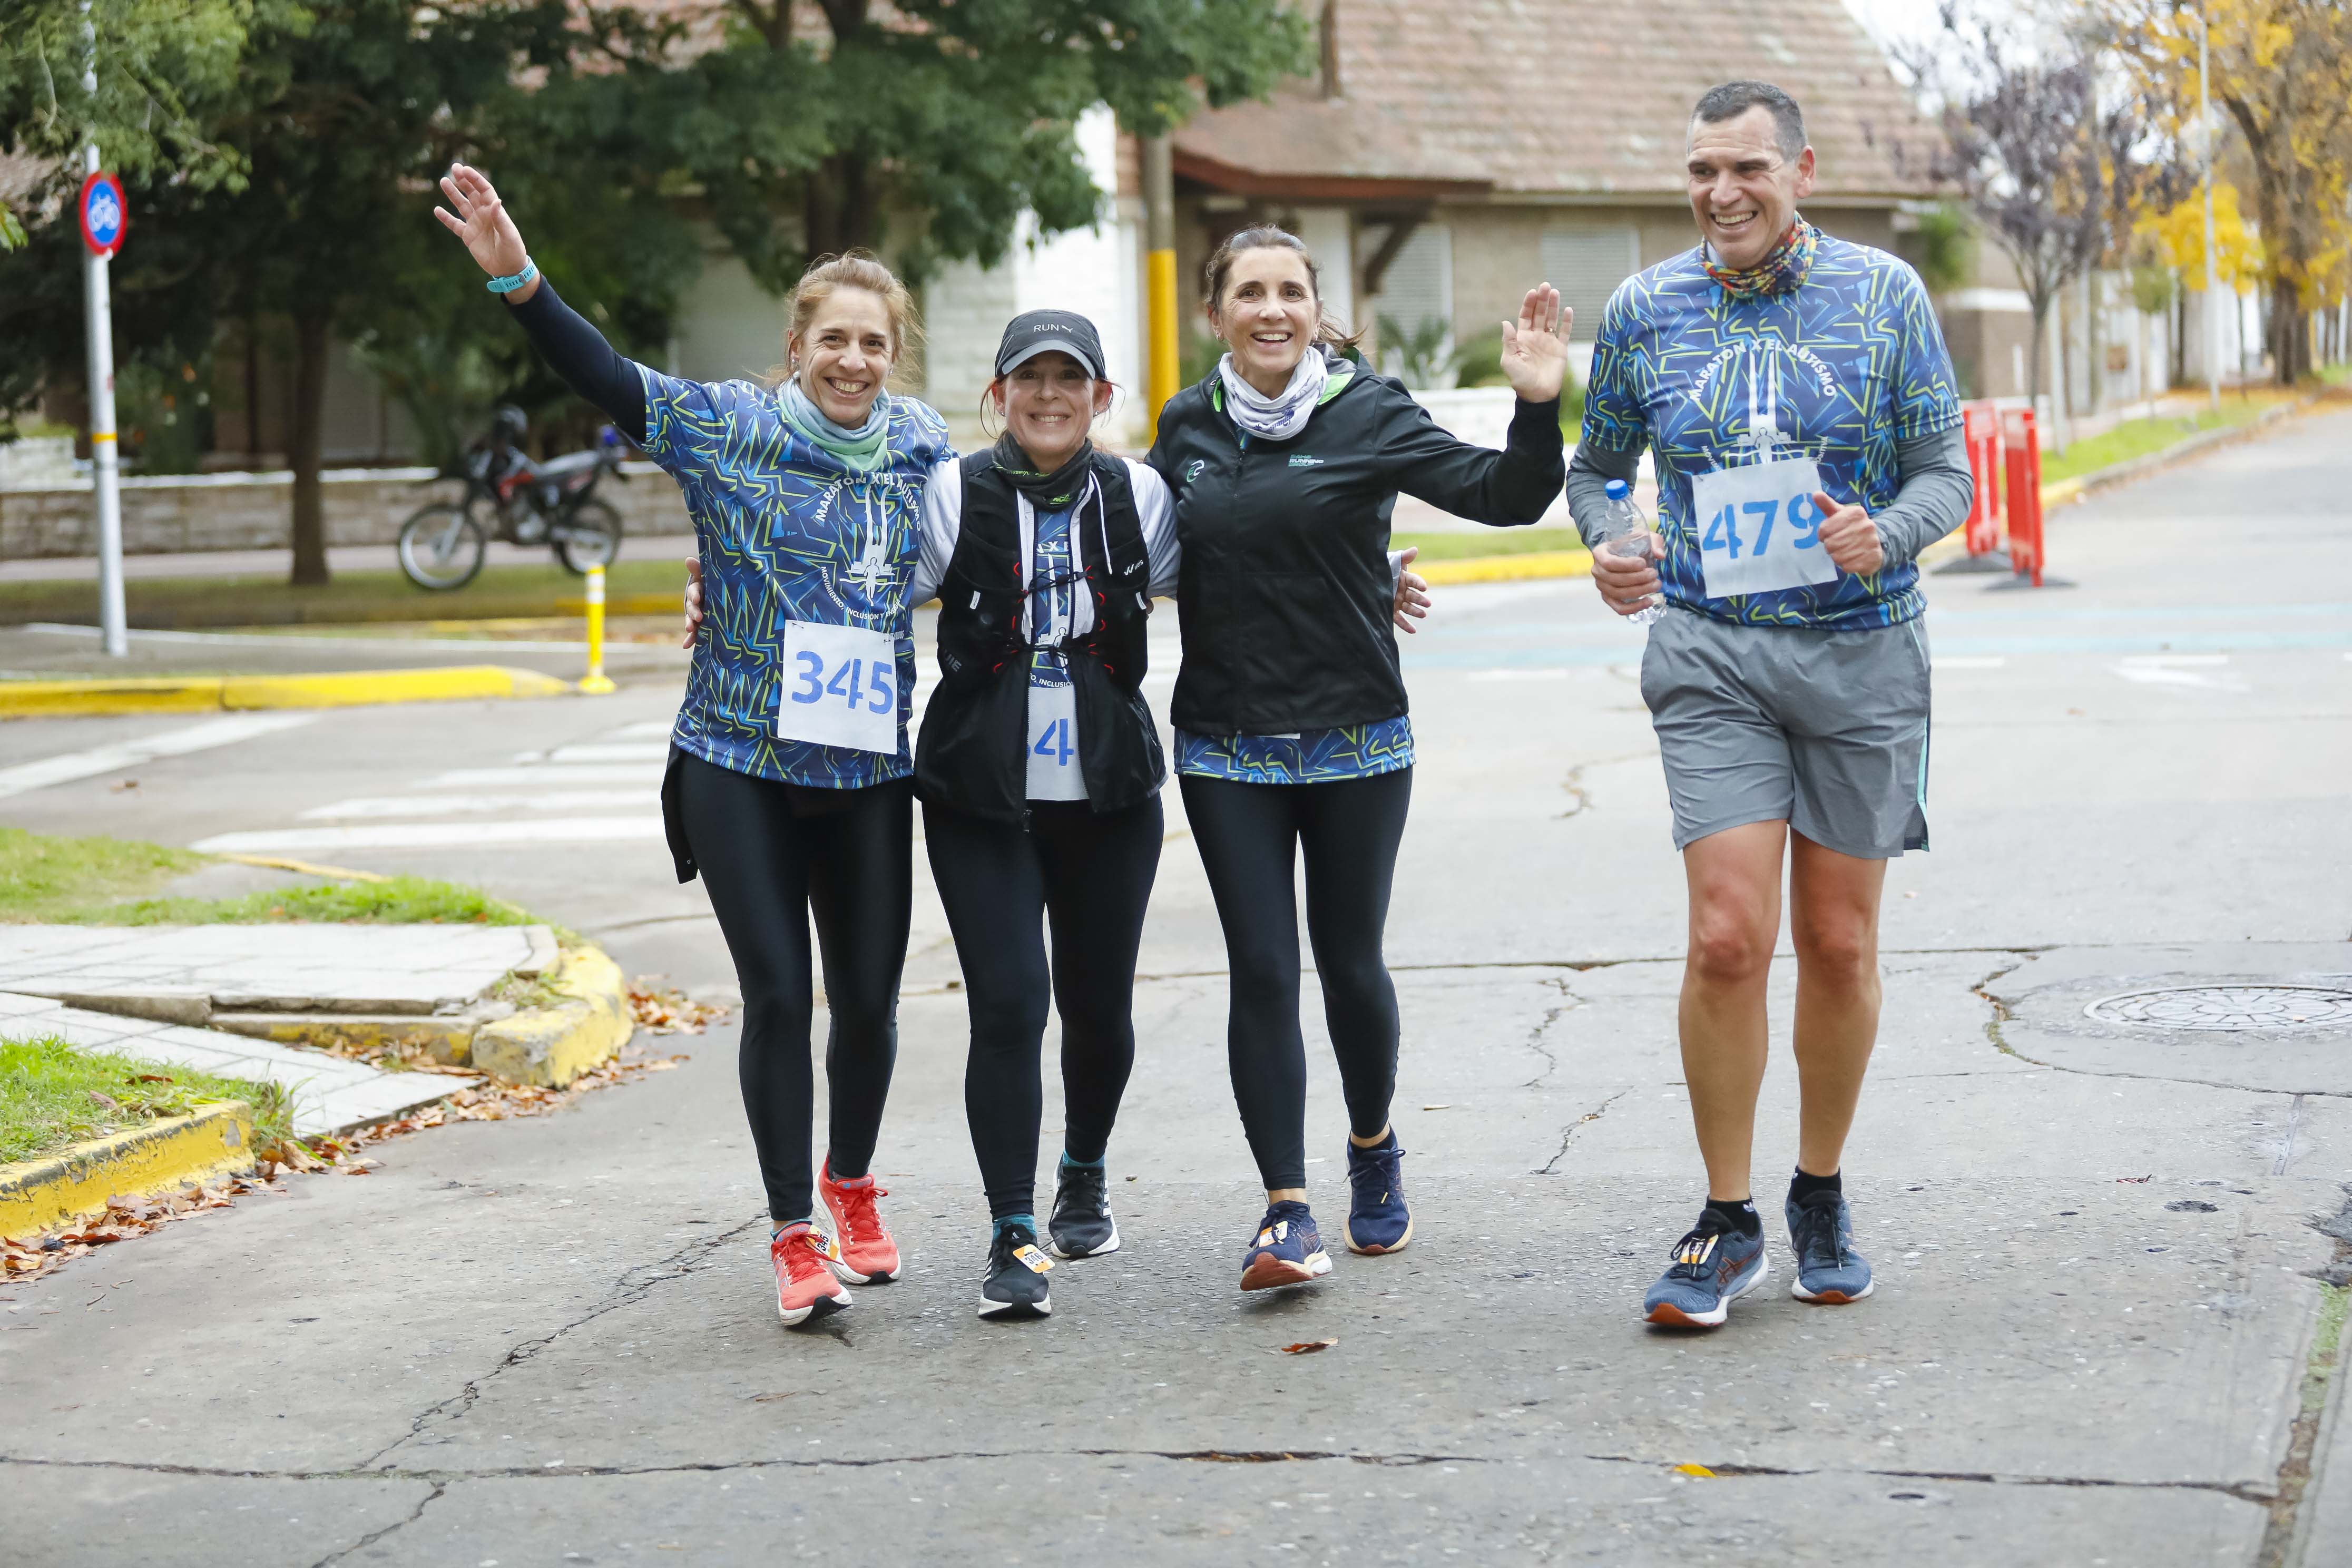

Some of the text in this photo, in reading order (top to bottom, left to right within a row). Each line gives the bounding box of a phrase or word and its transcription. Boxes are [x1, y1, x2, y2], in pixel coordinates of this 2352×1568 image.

[1690, 339, 1837, 401] MARATÓN X EL AUTISMO
[871, 472, 880, 484] X
[884, 473, 895, 486] EL
[896, 479, 922, 532] AUTISMO
[1702, 493, 1826, 559] 479
[846, 606, 879, 620] INCLUSIÓN
[791, 651, 894, 714] 345
[1038, 679, 1073, 688] INCLUSIÓ
[817, 1234, 829, 1251] 345
[1024, 1252, 1044, 1264] 346
